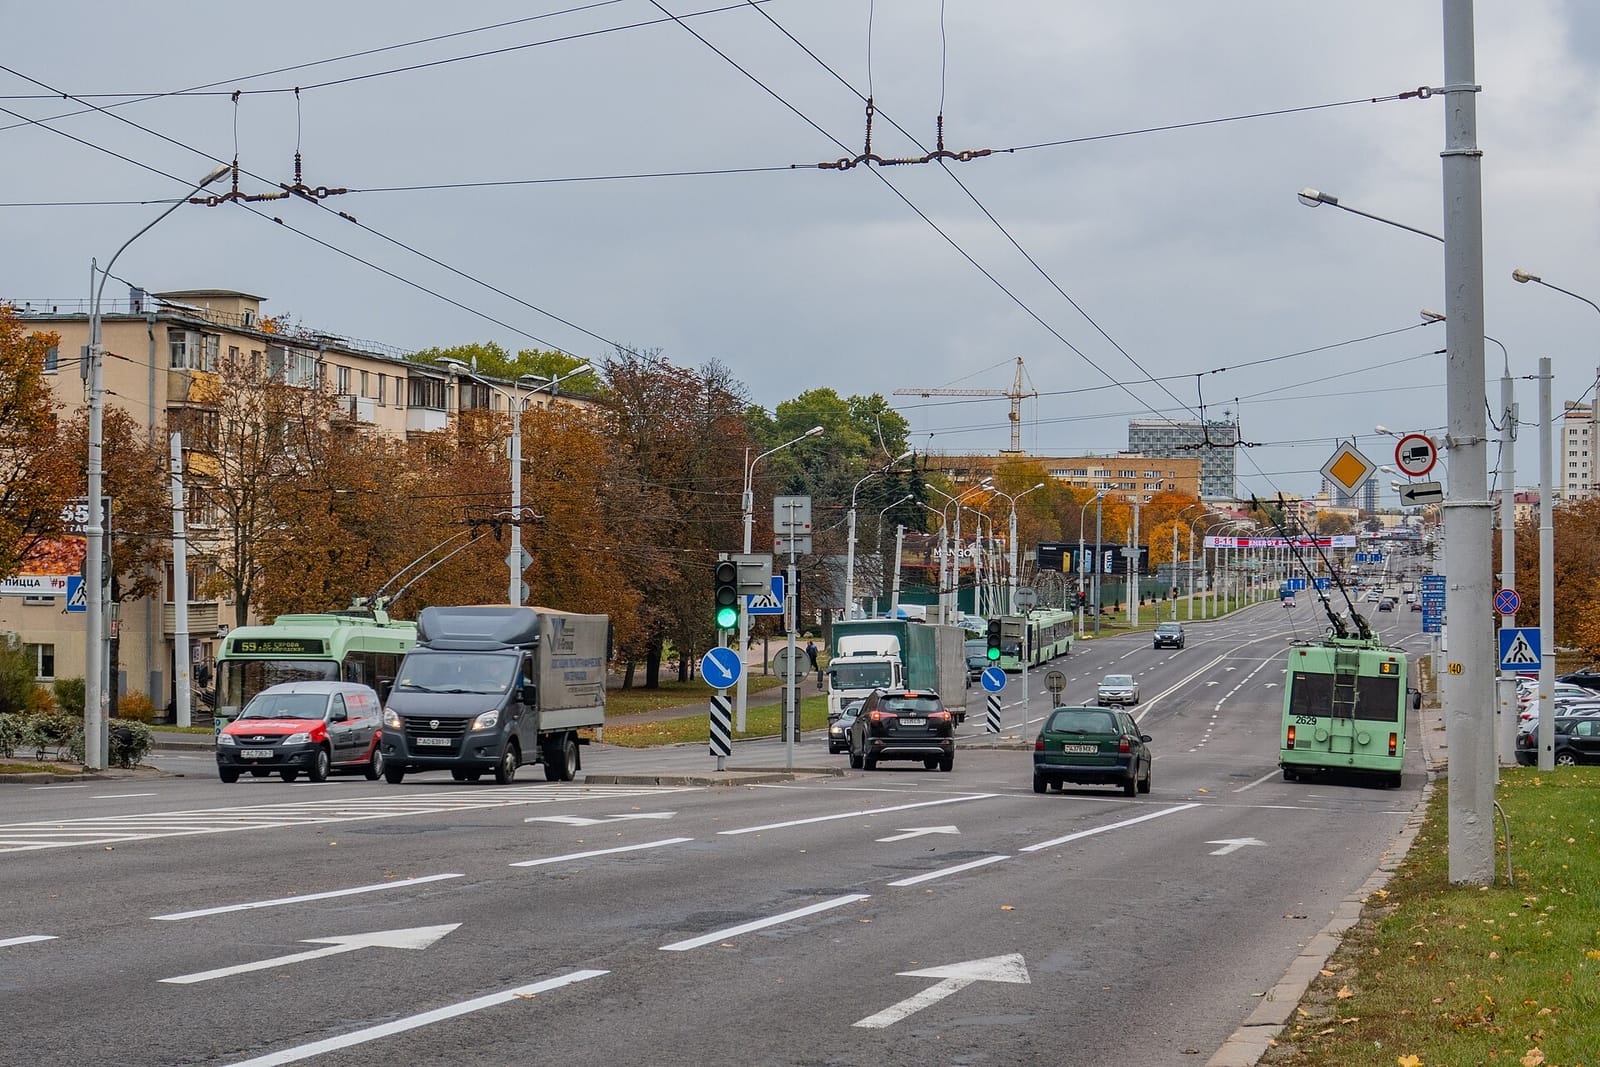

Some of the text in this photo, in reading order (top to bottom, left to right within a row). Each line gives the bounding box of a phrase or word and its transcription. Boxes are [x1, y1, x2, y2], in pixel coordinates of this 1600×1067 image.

[934, 548, 972, 558] MNGO
[5, 578, 41, 588] ПИЦЦА
[1383, 663, 1390, 673] 3
[1448, 663, 1462, 674] 140
[1295, 715, 1317, 726] 2629
